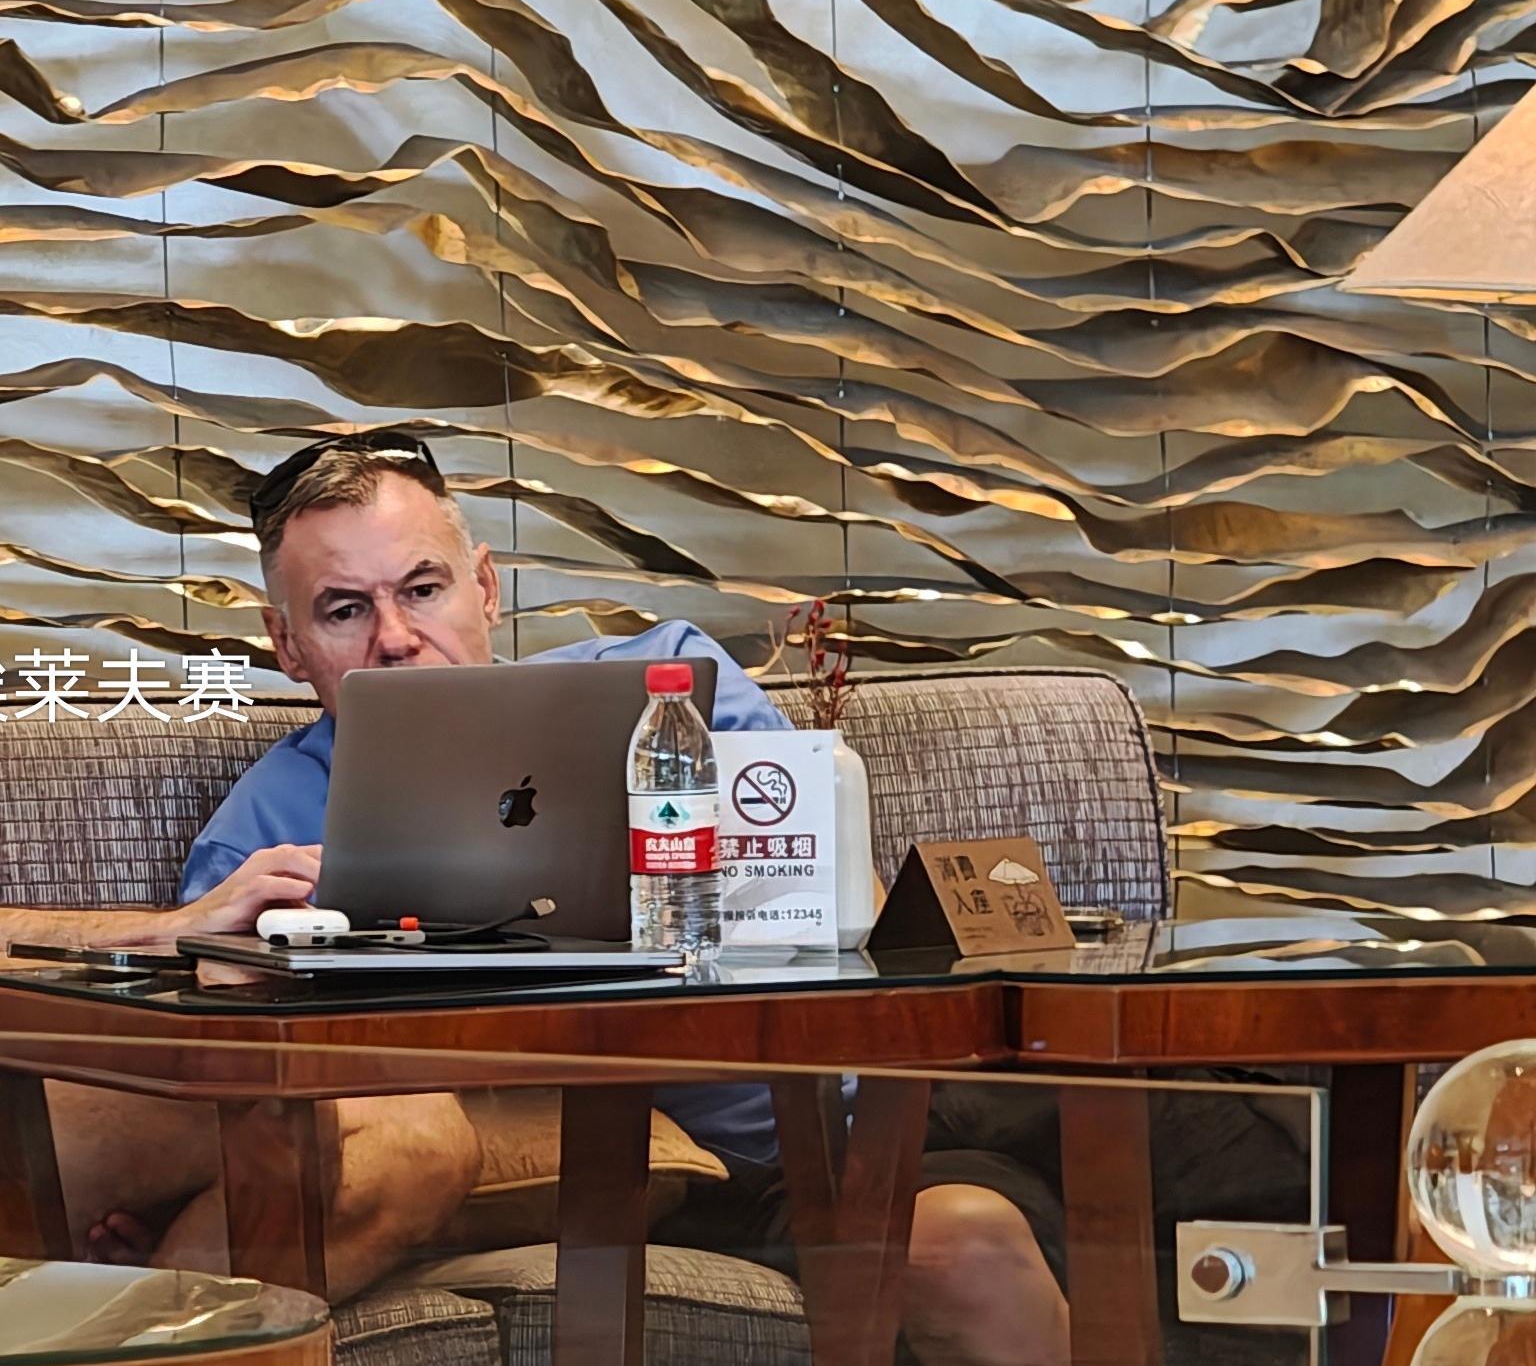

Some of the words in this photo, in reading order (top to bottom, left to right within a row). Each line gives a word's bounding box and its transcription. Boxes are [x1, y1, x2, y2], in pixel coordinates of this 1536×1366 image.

[719, 836, 812, 858] 禁止吸烟
[721, 865, 738, 877] NO
[745, 865, 815, 877] SMOKING
